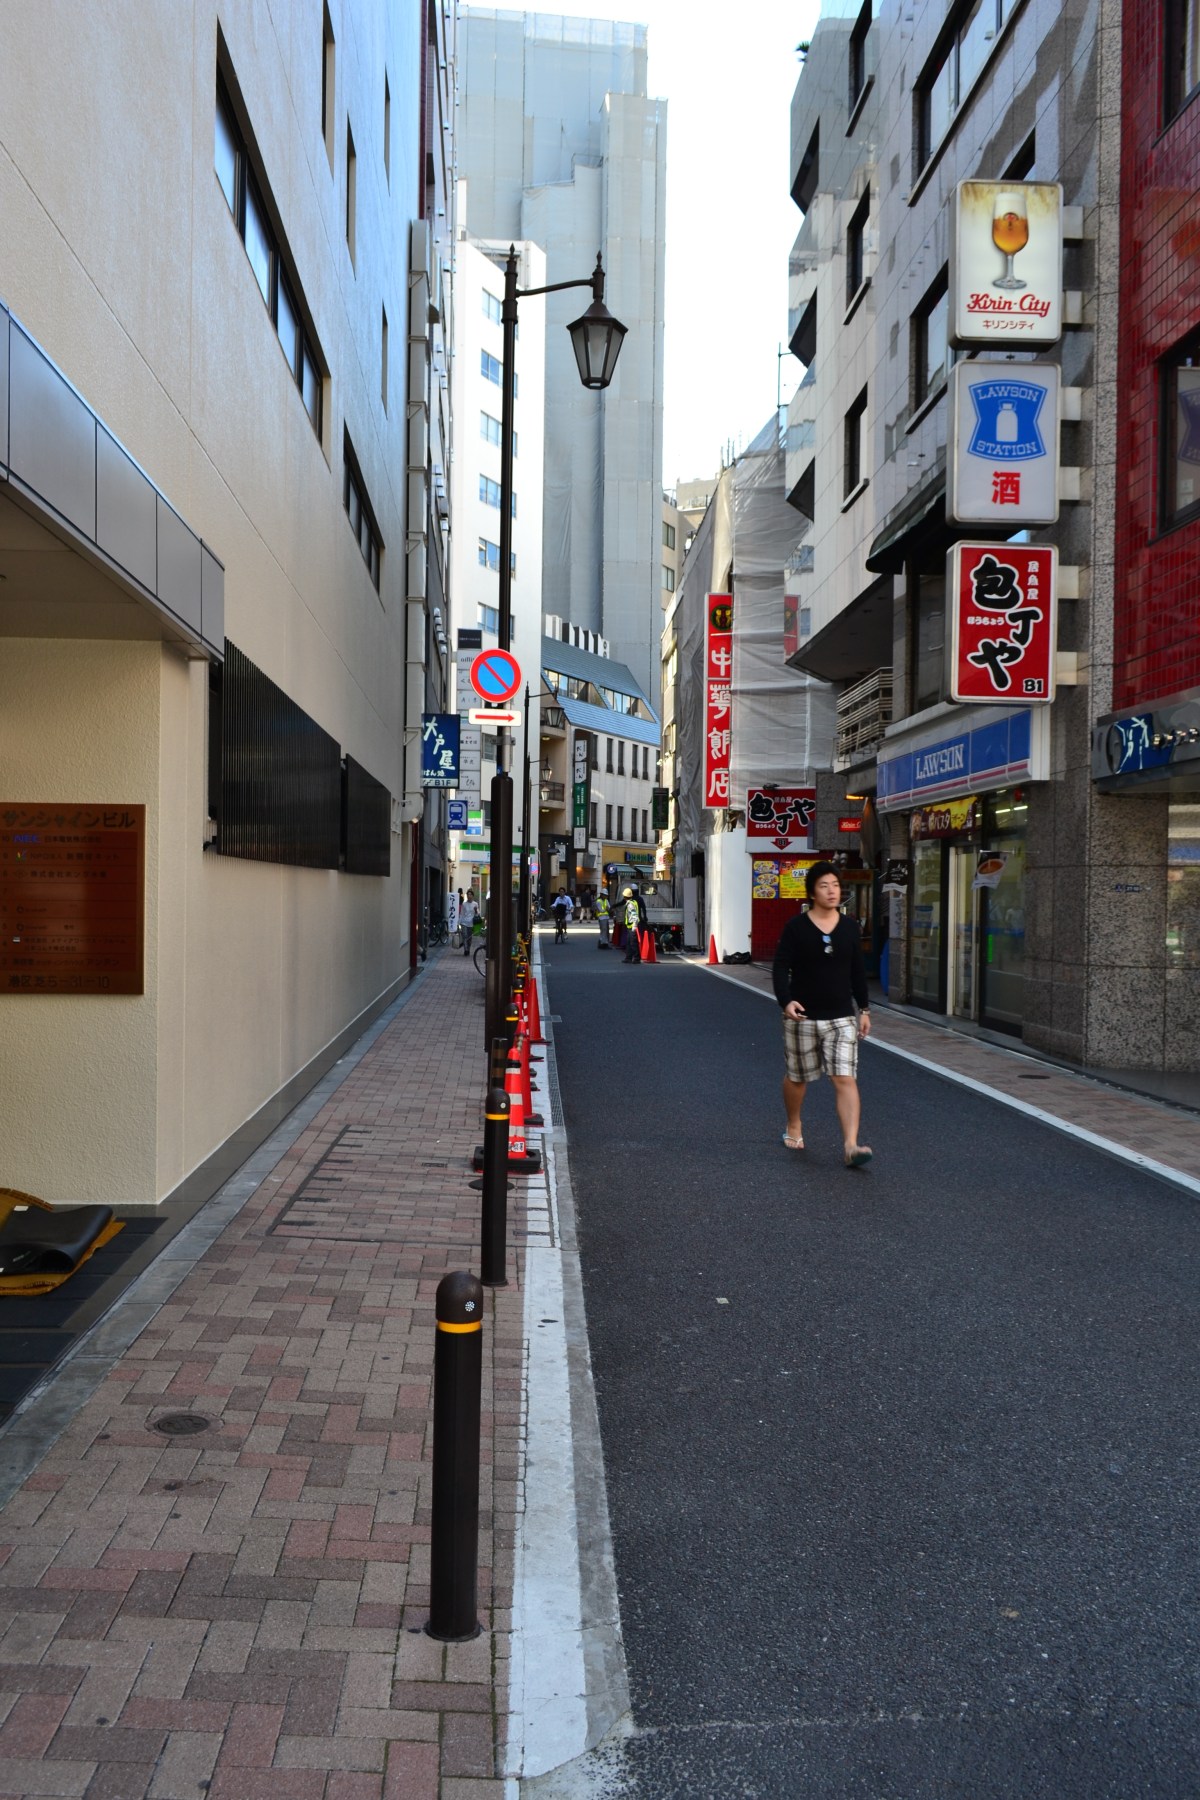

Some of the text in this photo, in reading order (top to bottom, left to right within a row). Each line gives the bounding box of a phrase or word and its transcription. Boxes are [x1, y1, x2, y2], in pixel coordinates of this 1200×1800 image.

[983, 320, 1034, 330] キリンシティ
[977, 385, 1040, 402] LAWSON
[976, 440, 1038, 456] STATION
[992, 471, 1021, 505] 酒
[1023, 679, 1044, 693] B1
[423, 716, 456, 770] 大戸屋
[916, 743, 964, 780] LAWSON
[423, 769, 445, 777] はん処
[749, 792, 816, 834] 包丁や
